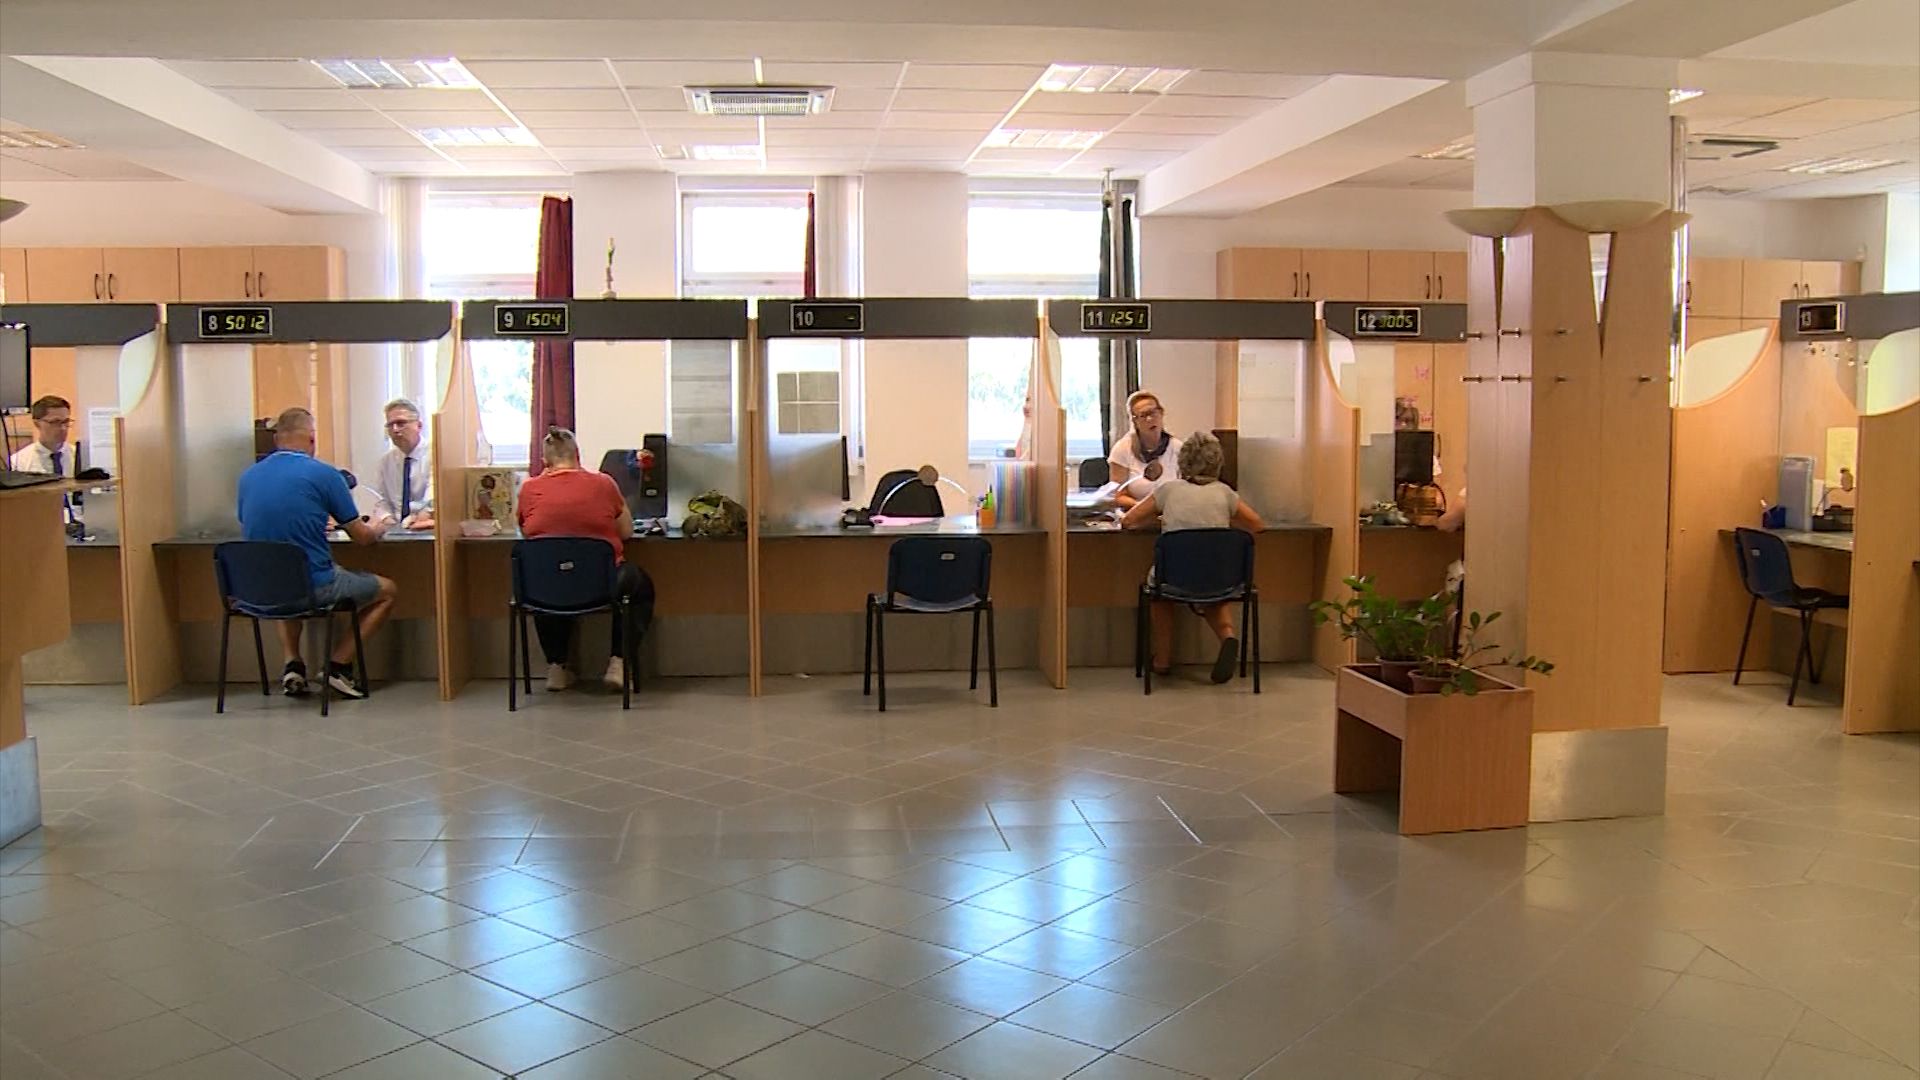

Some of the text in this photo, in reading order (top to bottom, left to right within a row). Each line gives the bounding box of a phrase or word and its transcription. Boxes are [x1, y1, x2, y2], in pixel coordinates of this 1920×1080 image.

[208, 315, 218, 331] 8
[504, 311, 561, 328] 9 1504
[795, 311, 814, 326] 10
[1088, 311, 1103, 326] 11
[1360, 314, 1376, 328] 12
